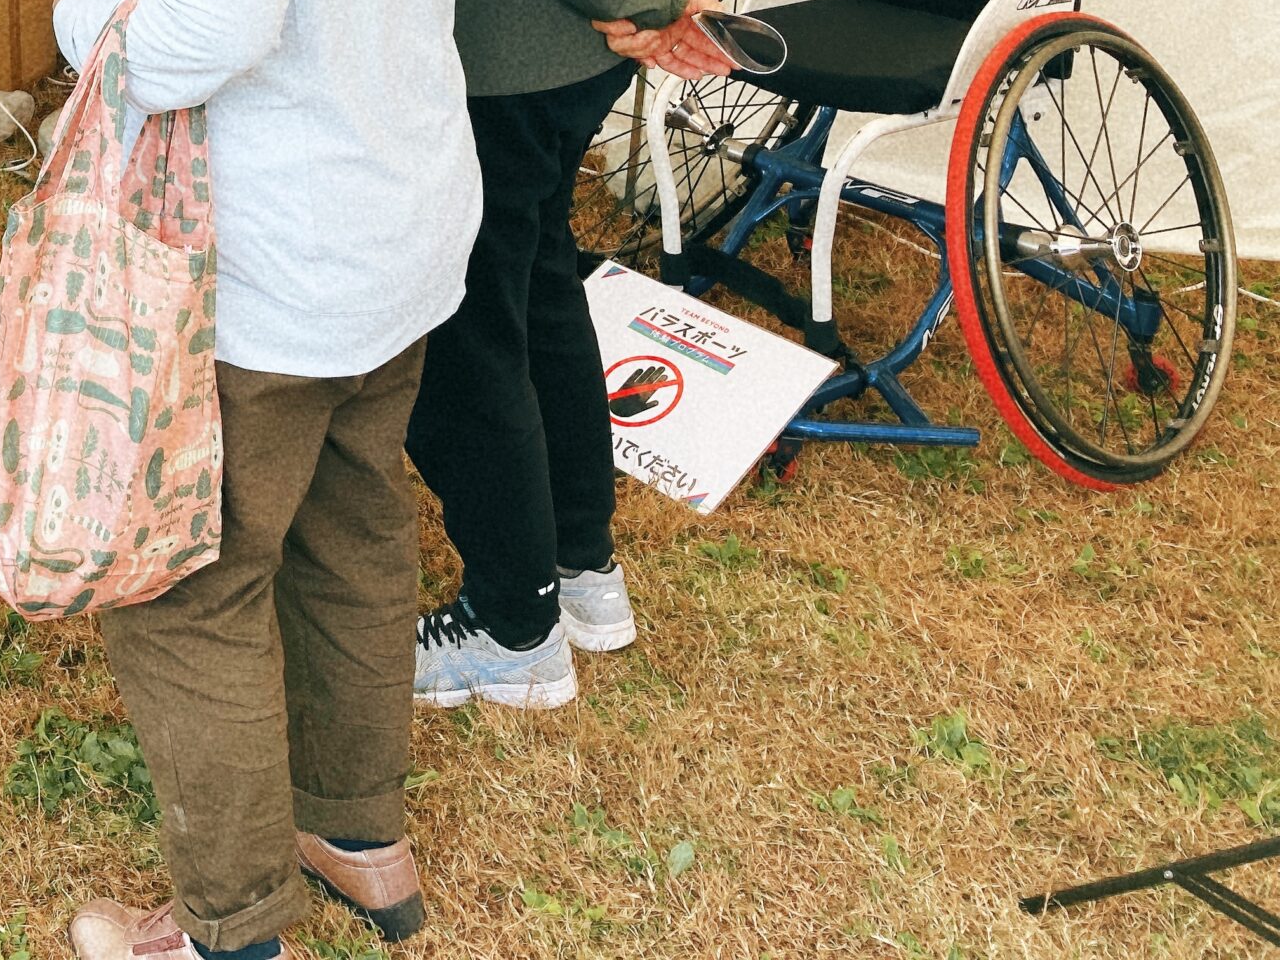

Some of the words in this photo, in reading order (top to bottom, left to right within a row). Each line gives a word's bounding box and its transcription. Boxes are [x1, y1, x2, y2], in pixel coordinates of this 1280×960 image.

[640, 306, 748, 359] パラスポーツ
[681, 307, 701, 321] TEAM
[701, 317, 730, 334] BEYOND
